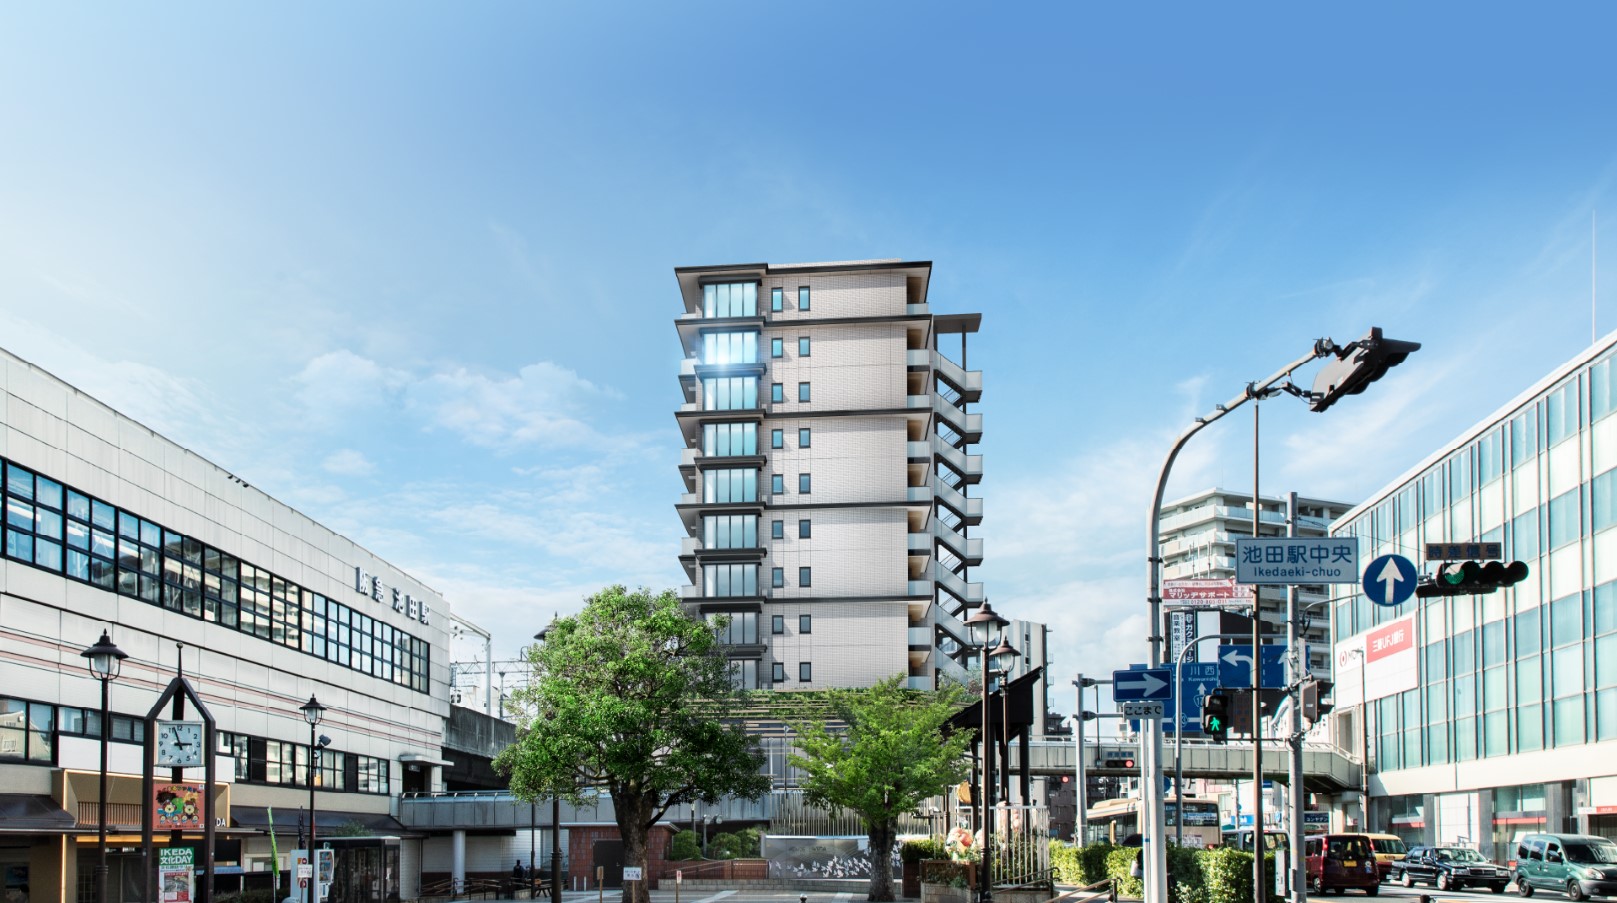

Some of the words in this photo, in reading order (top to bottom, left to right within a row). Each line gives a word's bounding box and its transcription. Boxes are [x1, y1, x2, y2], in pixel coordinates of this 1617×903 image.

[1243, 545, 1352, 564] 池田駅中央
[1254, 567, 1341, 577] Ikedaeki-chuo
[1190, 665, 1215, 676] 川西
[1125, 705, 1162, 716] ここまで
[160, 848, 193, 856] IKEDA
[160, 856, 193, 864] 文化DAY
